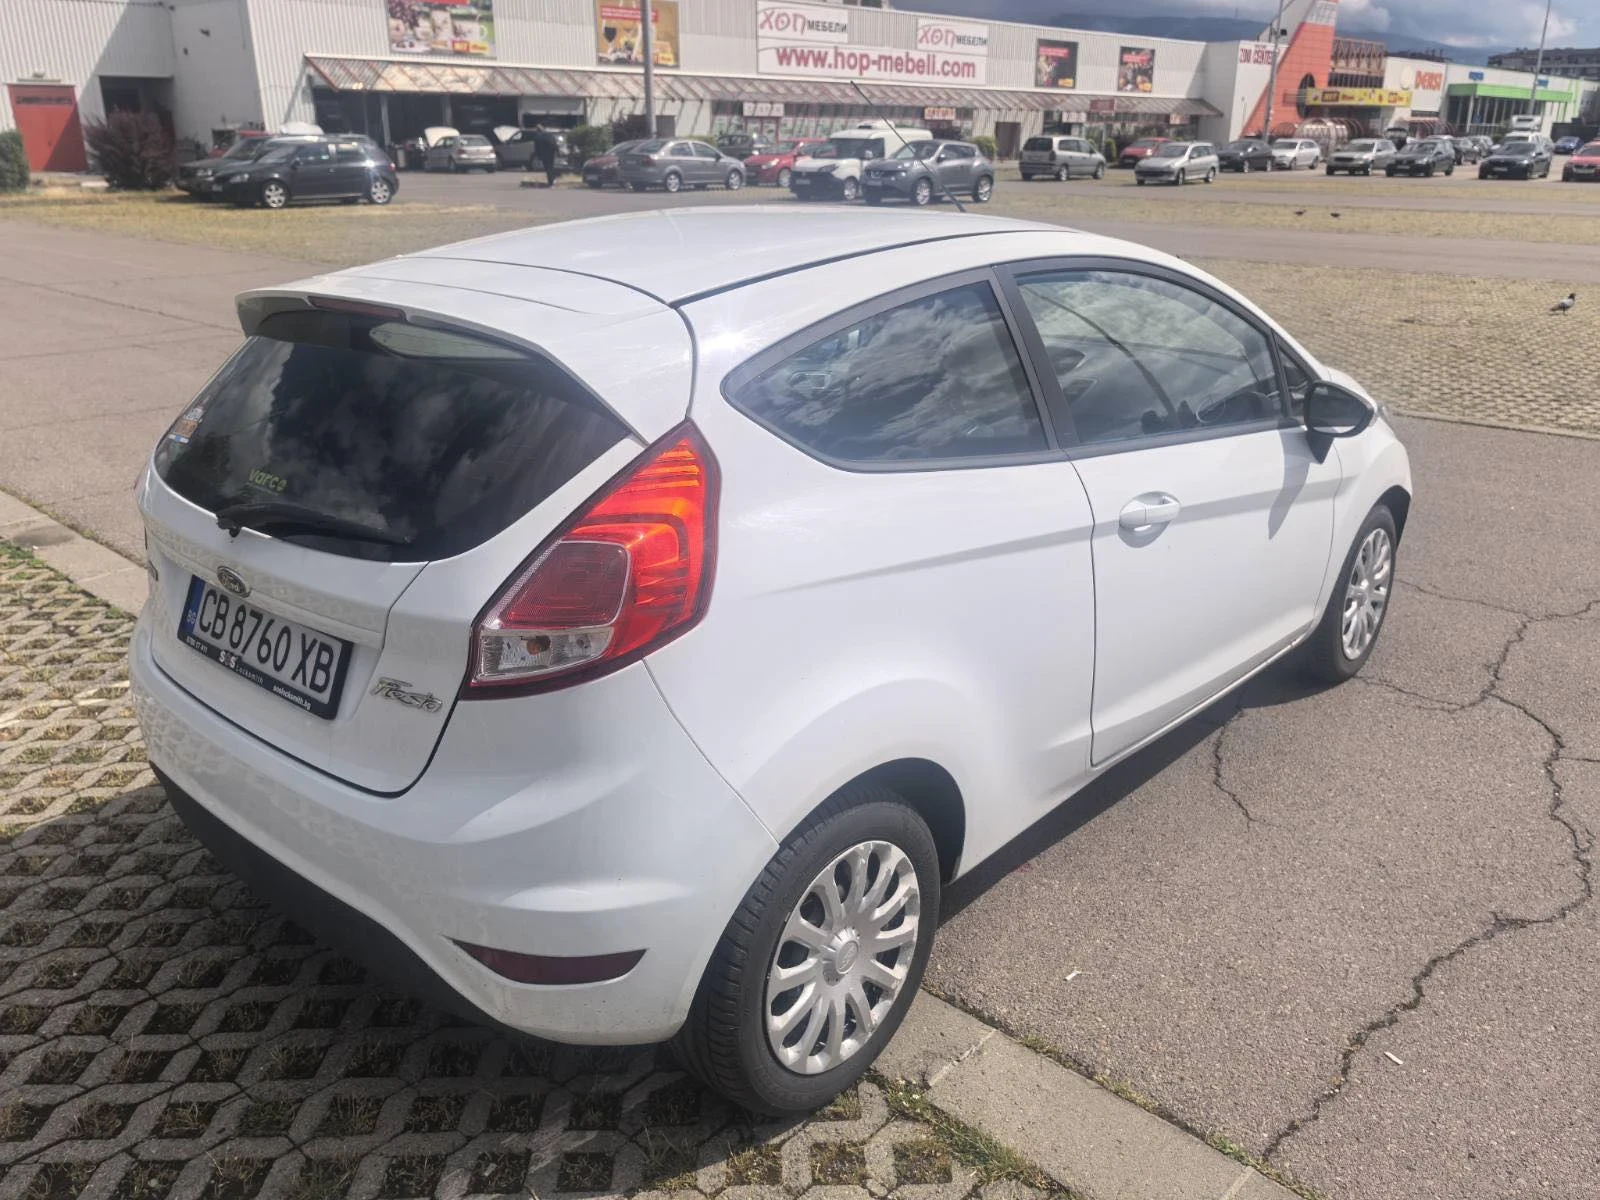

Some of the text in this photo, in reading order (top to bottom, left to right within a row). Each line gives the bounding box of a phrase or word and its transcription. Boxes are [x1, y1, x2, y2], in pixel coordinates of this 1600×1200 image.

[807, 20, 847, 33] МЕБЕЛИ
[776, 46, 976, 78] www.hop-mebeli.com
[1253, 48, 1280, 65] CENTE
[199, 589, 335, 694] CB 8760 XB
